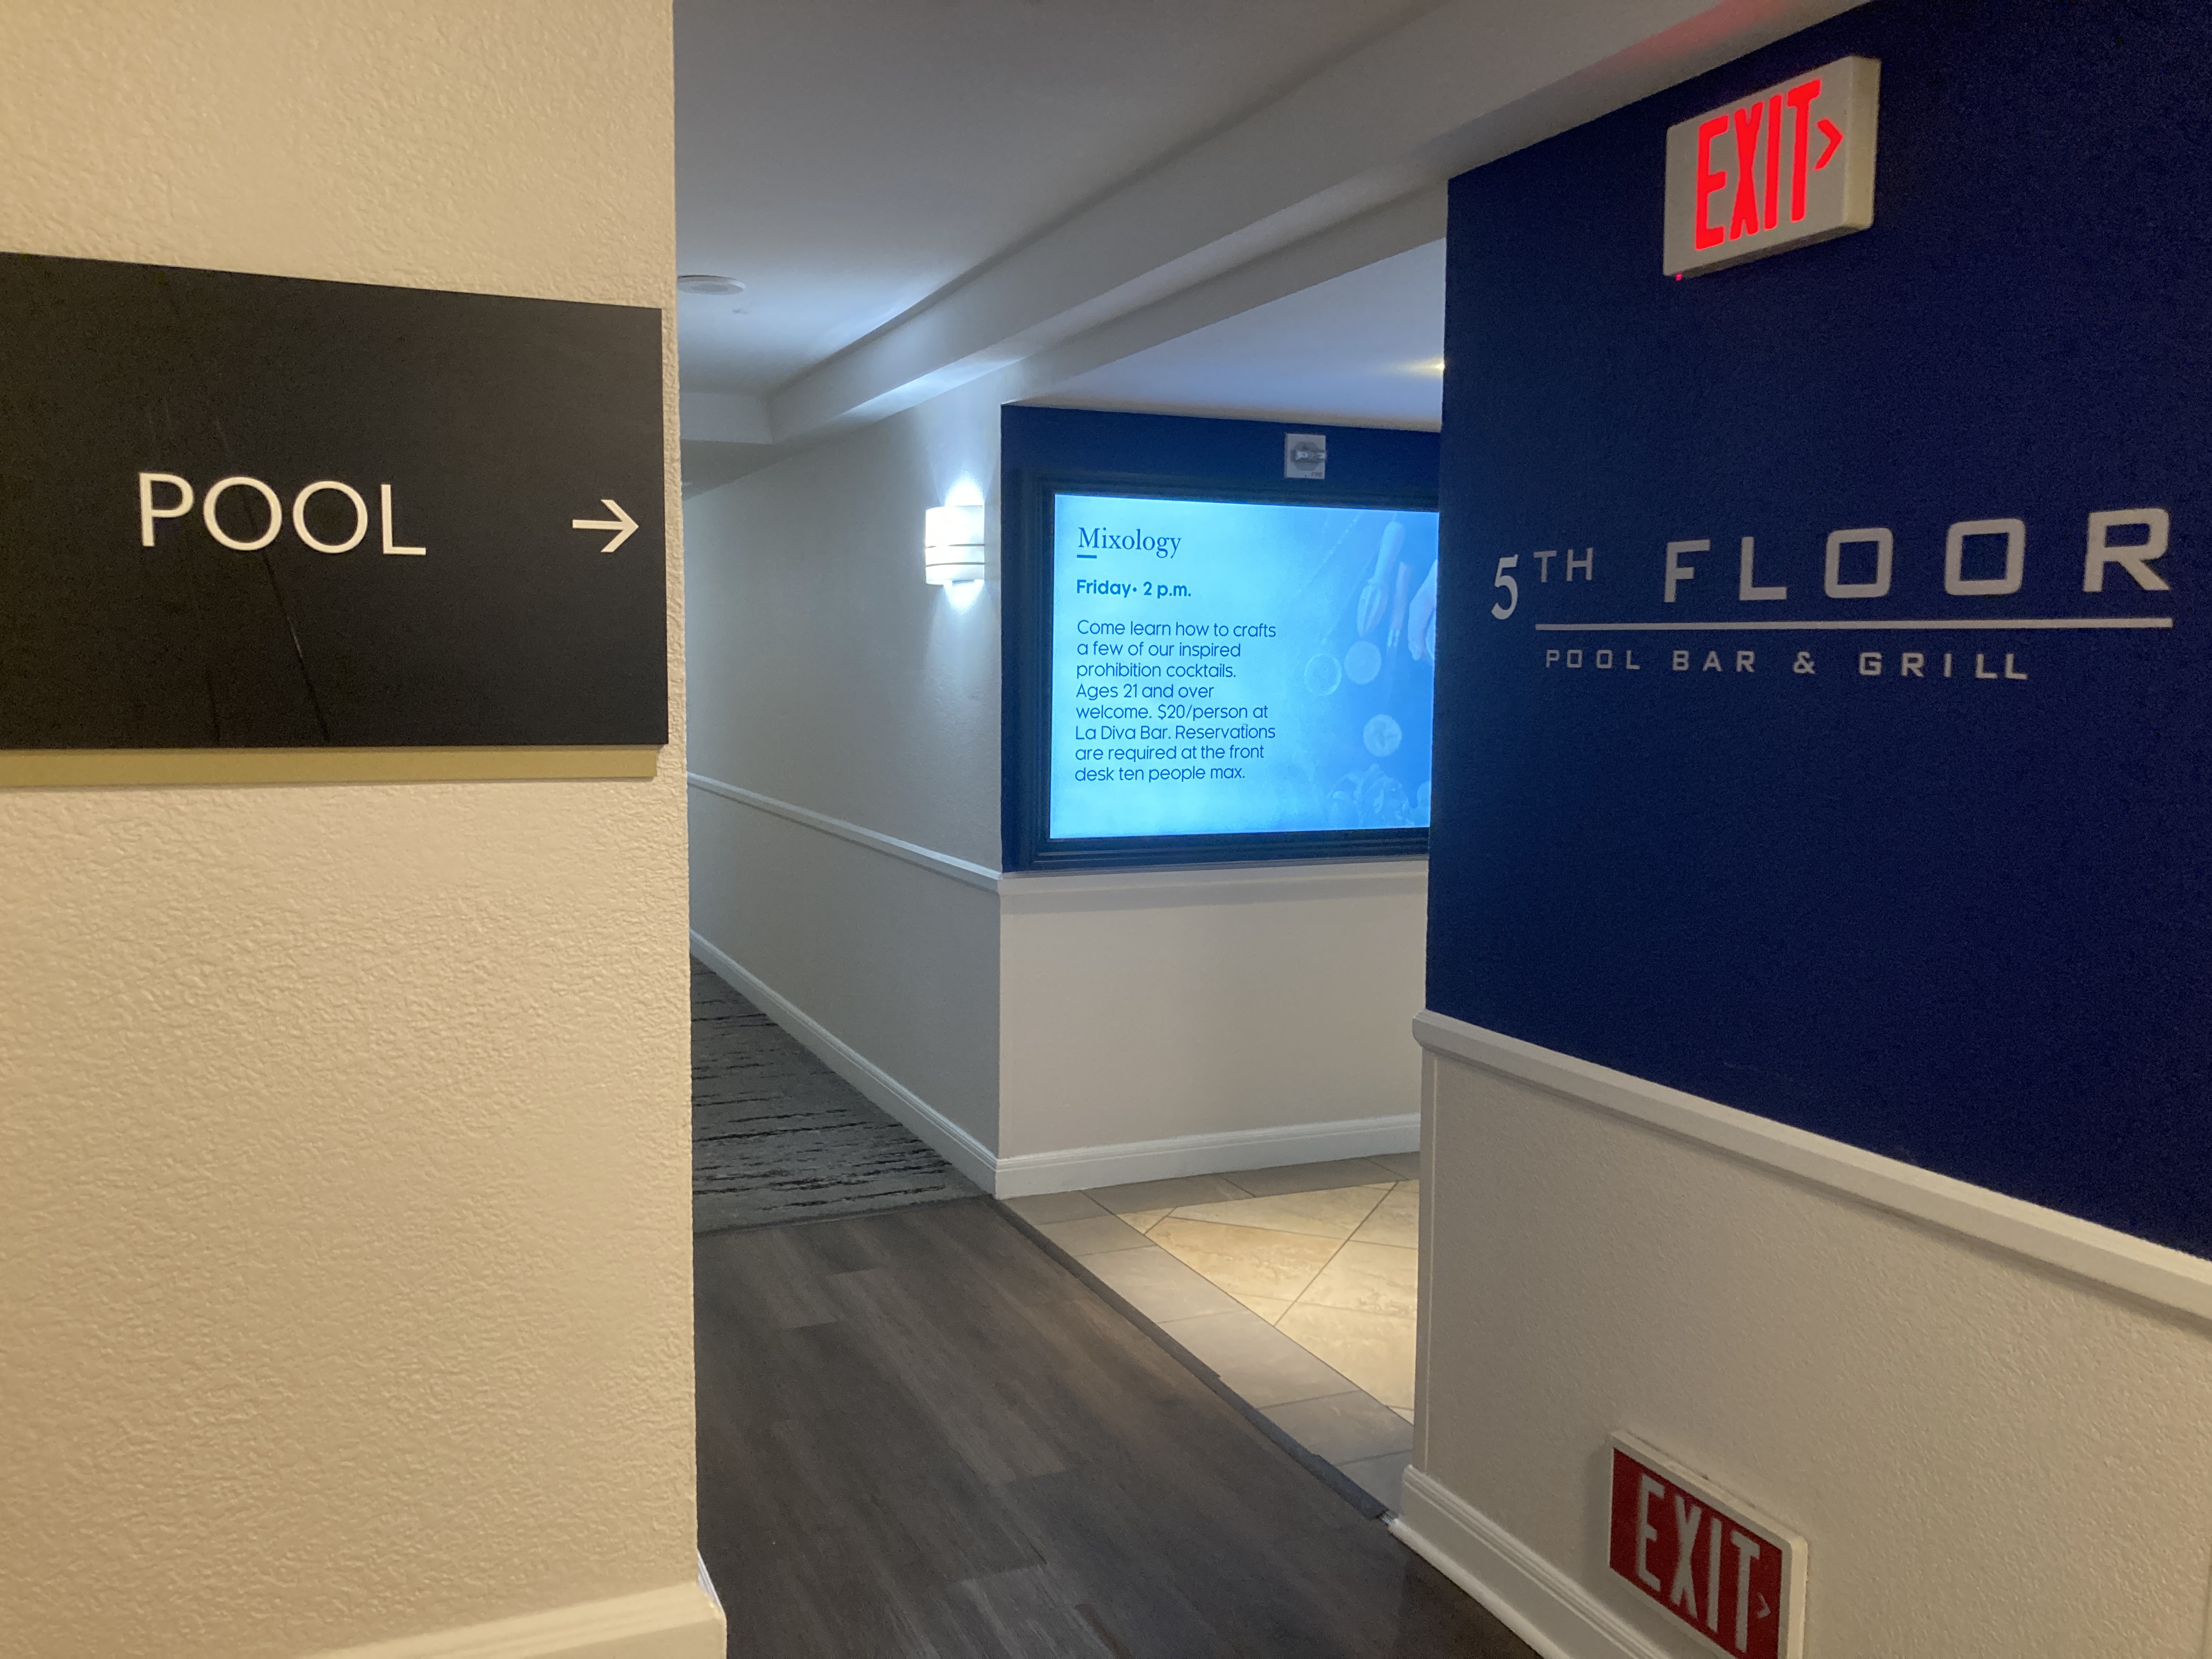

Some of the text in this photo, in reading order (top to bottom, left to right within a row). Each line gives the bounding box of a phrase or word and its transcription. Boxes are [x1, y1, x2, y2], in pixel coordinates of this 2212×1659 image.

[1694, 78, 1822, 251] EXIT
[139, 472, 427, 555] POOL
[1076, 527, 1182, 559] Mixology
[1491, 507, 2171, 620] 5TH FLOOR
[1143, 581, 1152, 596] 2
[1156, 584, 1192, 599] p.m.
[1077, 619, 1277, 637] Come learn how to crafts
[1077, 640, 1241, 660] a few of our inspired
[1076, 662, 1236, 680] prohibition cocktails.
[1545, 649, 2028, 680] POOL BAR & GRILL
[1075, 683, 1215, 701] Ages 21 and over
[1075, 703, 1269, 721] welcome. $20/person at
[1075, 723, 1276, 740] La Diva Bar. Reservations
[1075, 744, 1265, 763] are required at the front
[1075, 765, 1245, 783] desk ten people max.
[1636, 1473, 1761, 1654] EXIT
